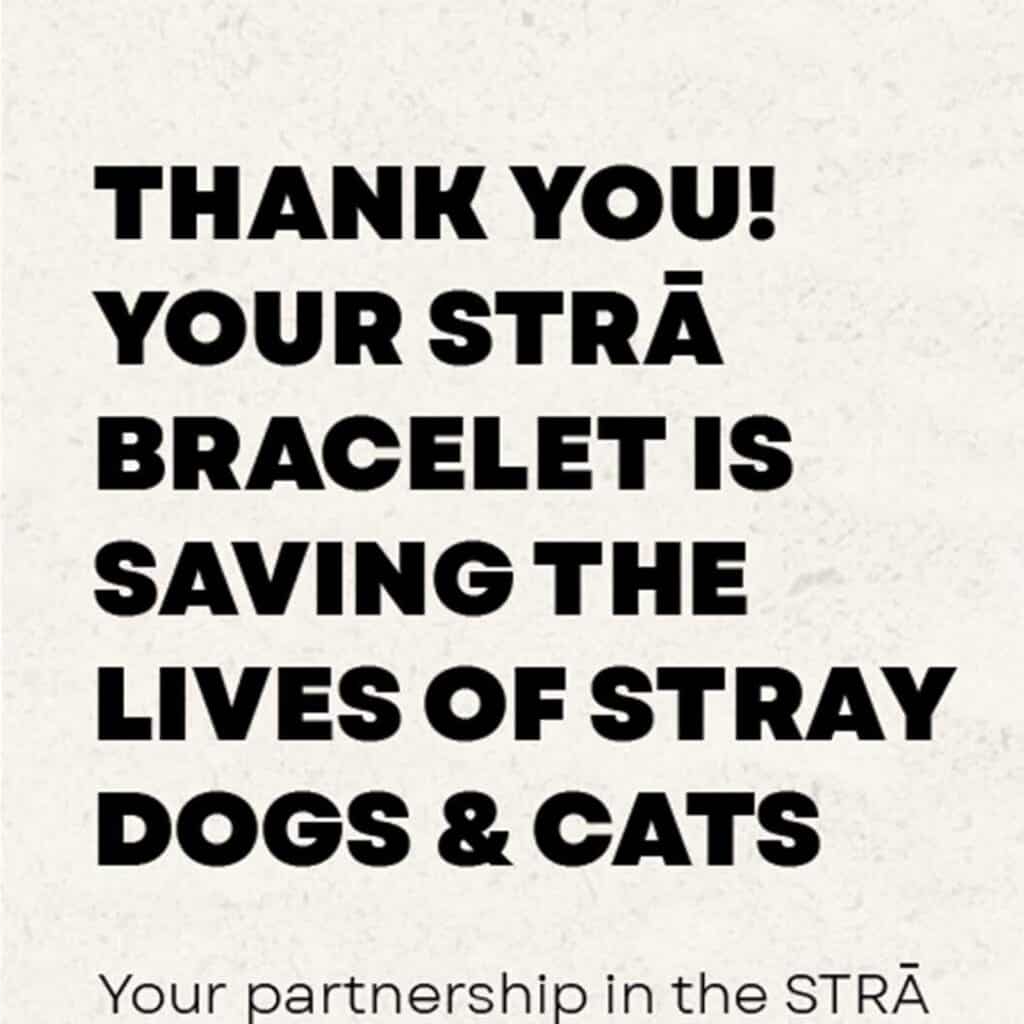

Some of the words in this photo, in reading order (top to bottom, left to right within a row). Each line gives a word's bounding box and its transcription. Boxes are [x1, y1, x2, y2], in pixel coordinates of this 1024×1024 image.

[94, 165, 488, 240] THANK
[509, 165, 774, 240] YOU!
[93, 290, 402, 366] YOUR
[429, 271, 723, 366] STRĀ
[98, 415, 666, 491] BRACELET
[695, 416, 792, 491] IS
[94, 541, 513, 616] SAVING
[534, 542, 747, 615] THE
[98, 666, 401, 741] LIVES
[424, 666, 566, 741] OF
[591, 666, 957, 741] STRAY
[98, 791, 410, 867] DOGS
[438, 791, 512, 867] &
[534, 791, 820, 867] CATS
[99, 974, 226, 1014] Your
[249, 972, 586, 1024] partnership
[608, 975, 652, 1013] in
[672, 972, 766, 1014] the
[787, 963, 928, 1013] STRĀ
